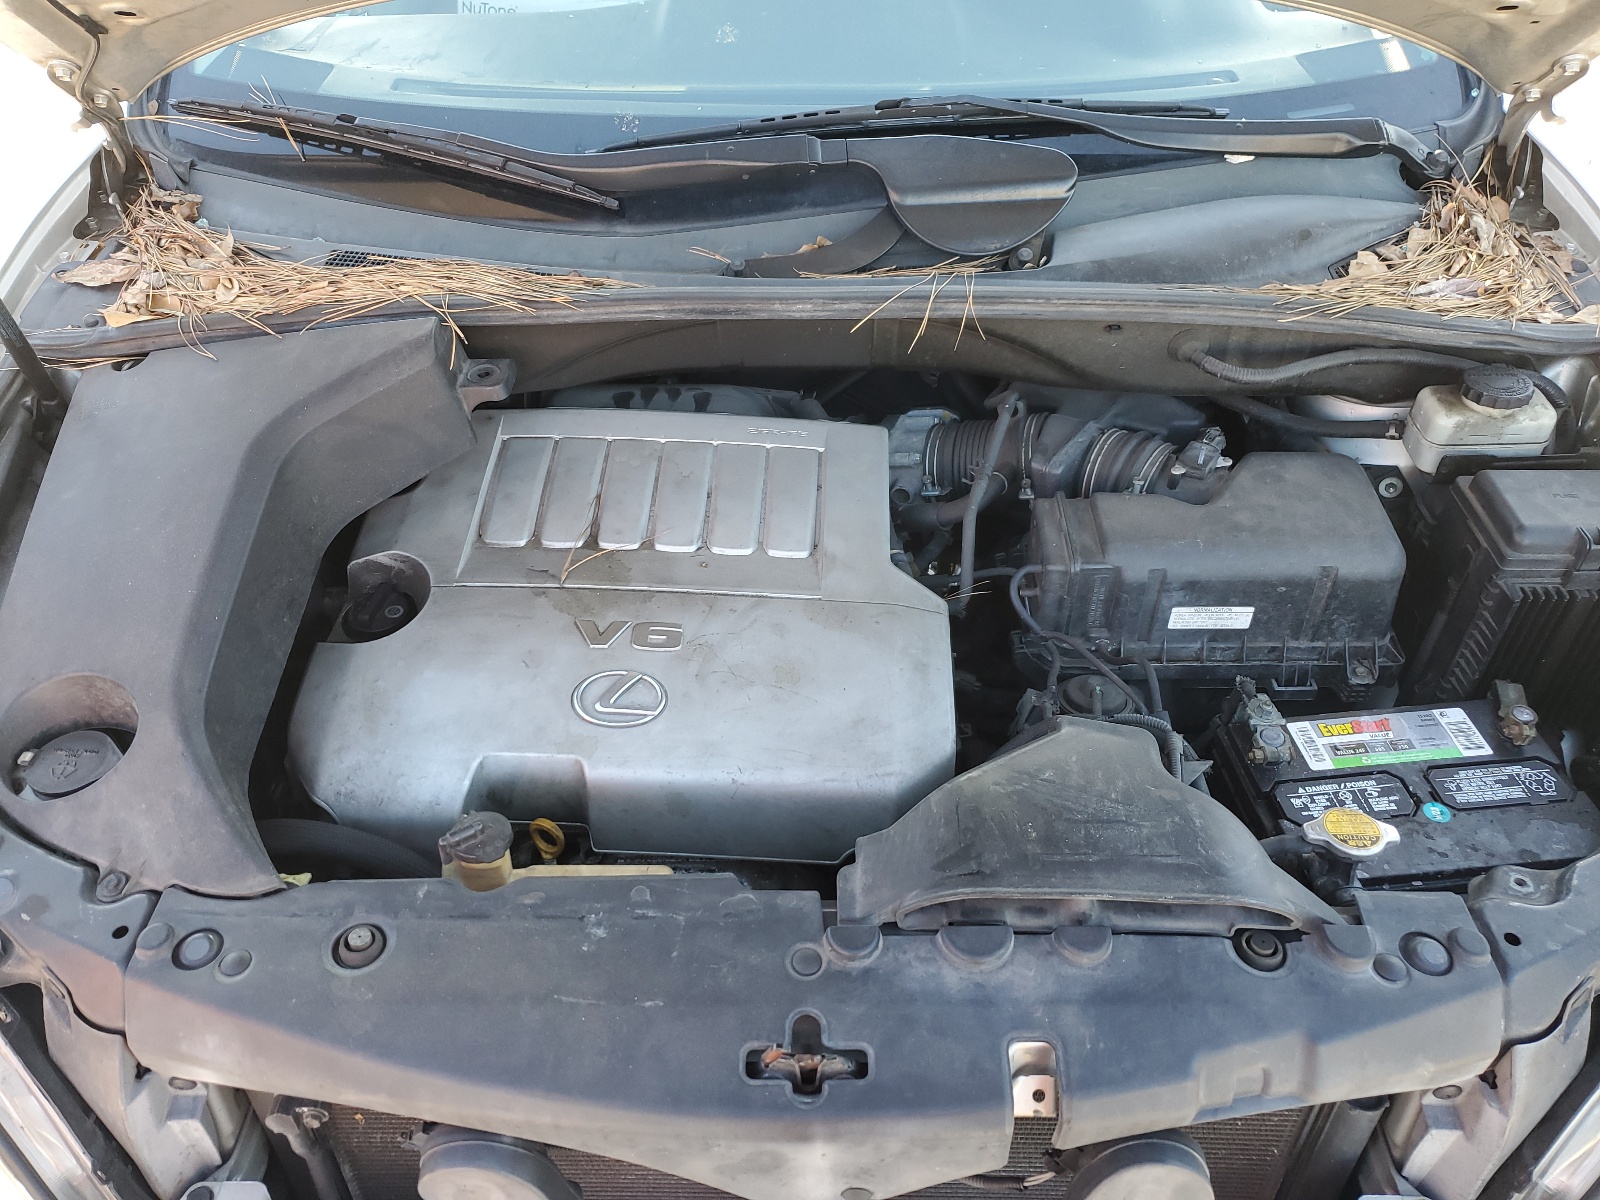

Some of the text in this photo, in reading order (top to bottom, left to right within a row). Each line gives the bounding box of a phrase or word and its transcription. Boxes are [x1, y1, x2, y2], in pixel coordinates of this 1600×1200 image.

[575, 619, 684, 651] V6
[1305, 784, 1340, 792] DANGER
[1346, 780, 1377, 788] POISON
